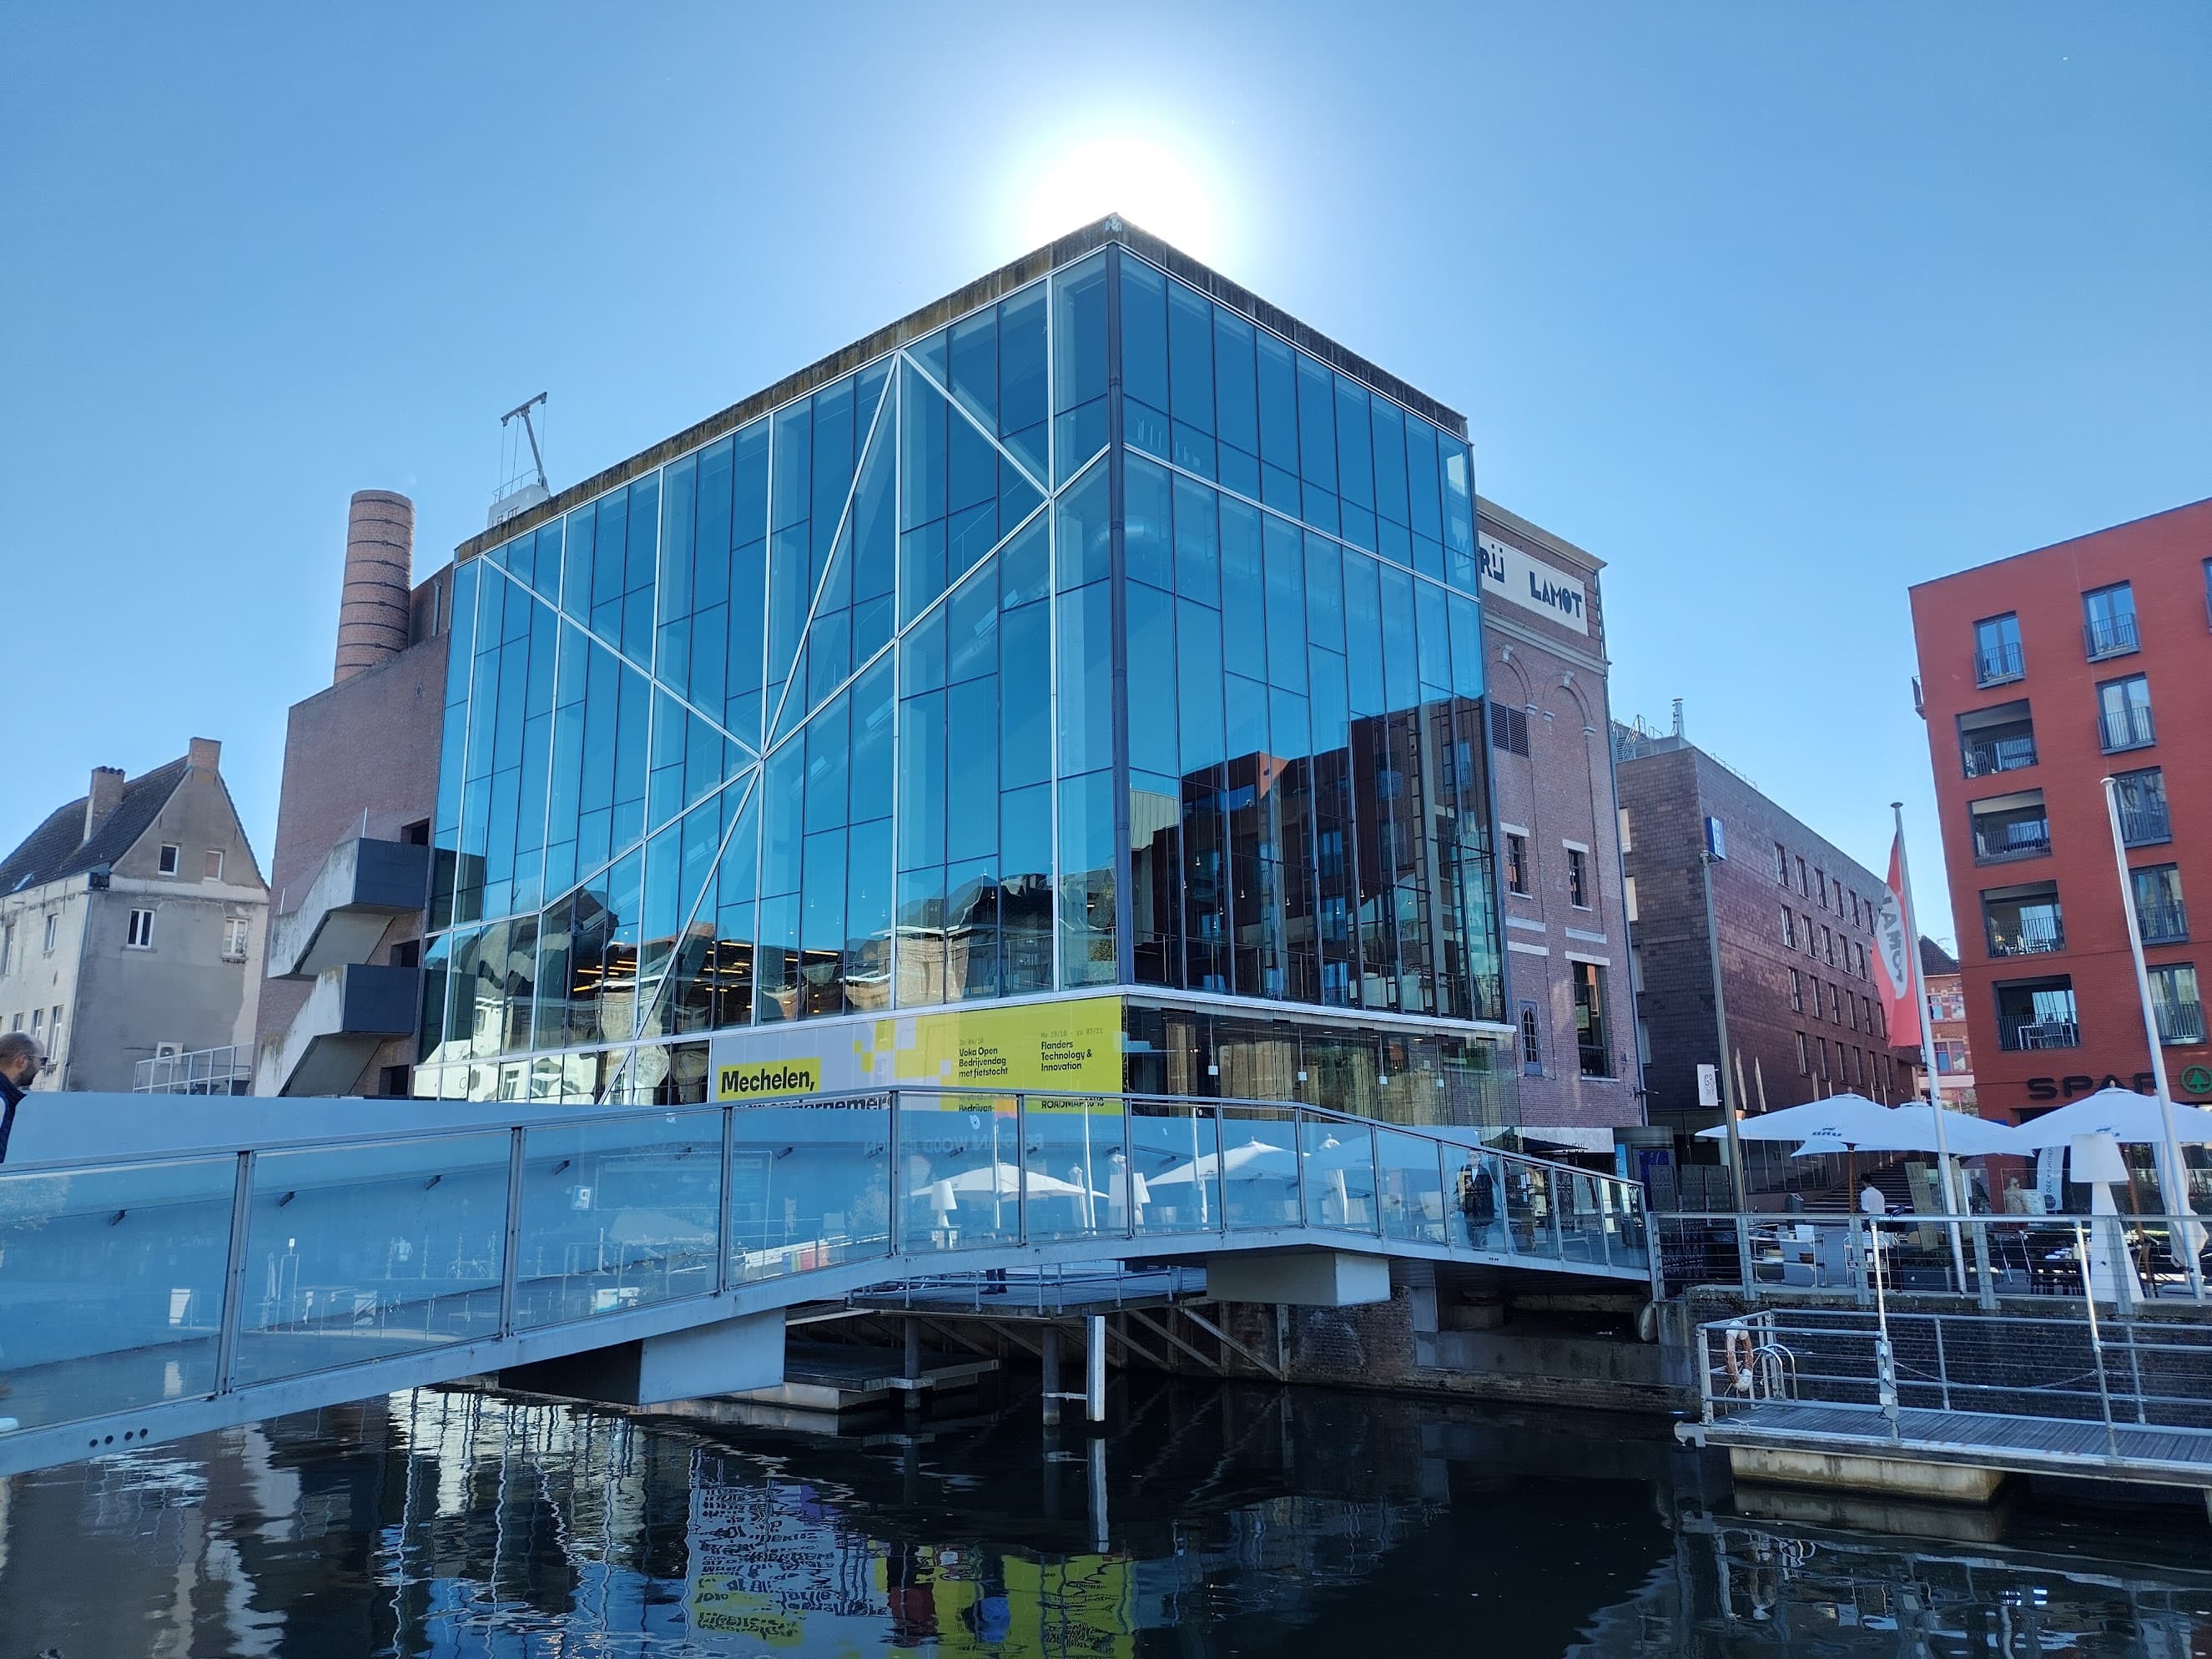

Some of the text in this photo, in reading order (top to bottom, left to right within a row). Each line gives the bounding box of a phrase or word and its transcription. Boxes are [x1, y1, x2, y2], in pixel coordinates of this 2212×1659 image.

[1529, 571, 1583, 619] LAMOT
[1041, 1041, 1074, 1050] Flanders
[960, 1046, 998, 1058] Voka Open
[1041, 1049, 1093, 1061] Technology &
[959, 1057, 1006, 1069] Bedrijvendag
[1041, 1062, 1082, 1072] Innovation
[959, 1067, 1009, 1078] met fietstocht
[721, 1066, 815, 1094] Mechelen,
